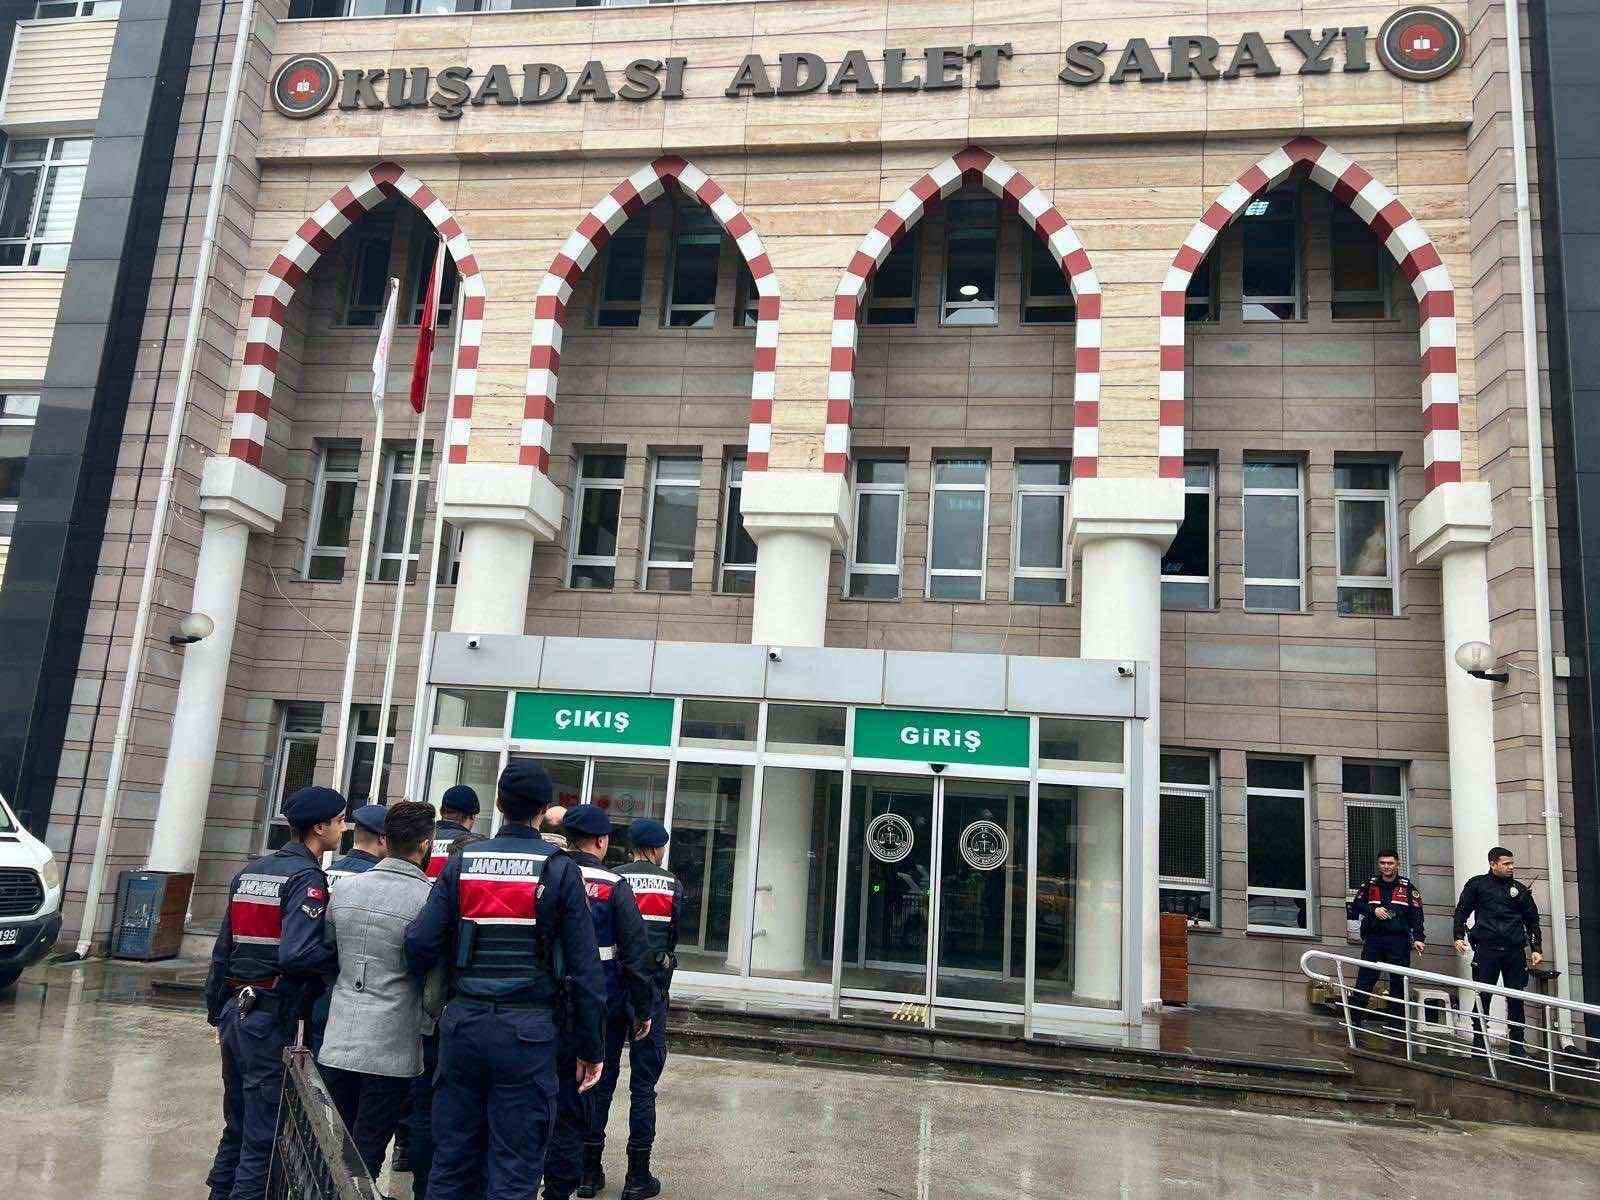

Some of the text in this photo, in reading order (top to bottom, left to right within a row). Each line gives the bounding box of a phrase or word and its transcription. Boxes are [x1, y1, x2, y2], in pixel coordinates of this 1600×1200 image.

[338, 25, 1371, 121] KUŞADASI ADALET SARAYI
[555, 709, 630, 733] ÇIKIŞ
[468, 858, 534, 875] JANDARMA
[237, 880, 281, 898] JANDARMA
